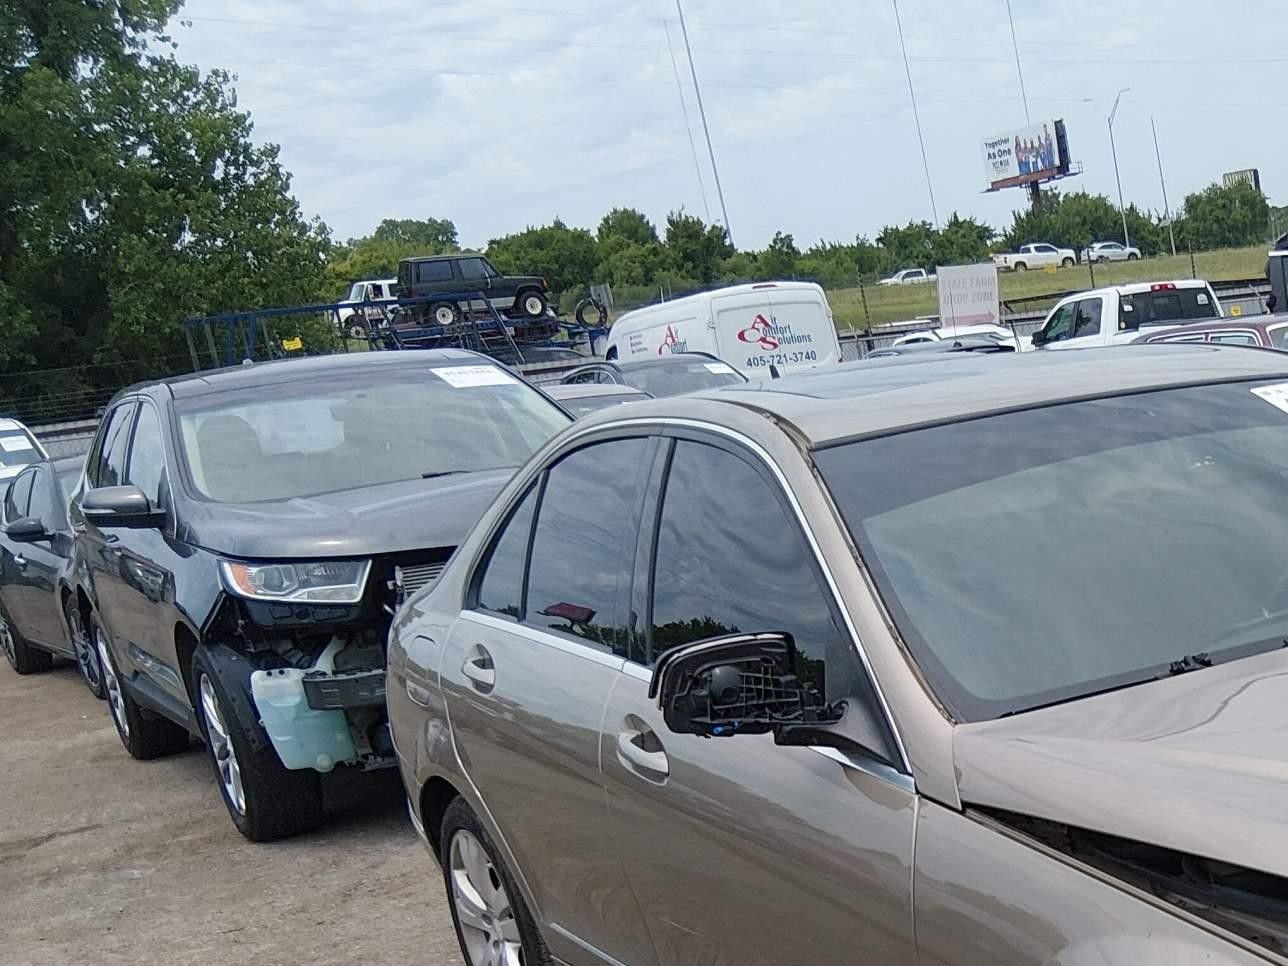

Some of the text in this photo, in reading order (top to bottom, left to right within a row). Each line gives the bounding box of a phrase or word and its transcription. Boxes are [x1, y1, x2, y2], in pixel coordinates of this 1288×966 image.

[984, 137, 1010, 149] Together
[987, 148, 1012, 160] As One
[942, 276, 995, 289] STATE FARM
[943, 291, 995, 305] DROP ZONE
[746, 350, 817, 368] 405-721-3740
